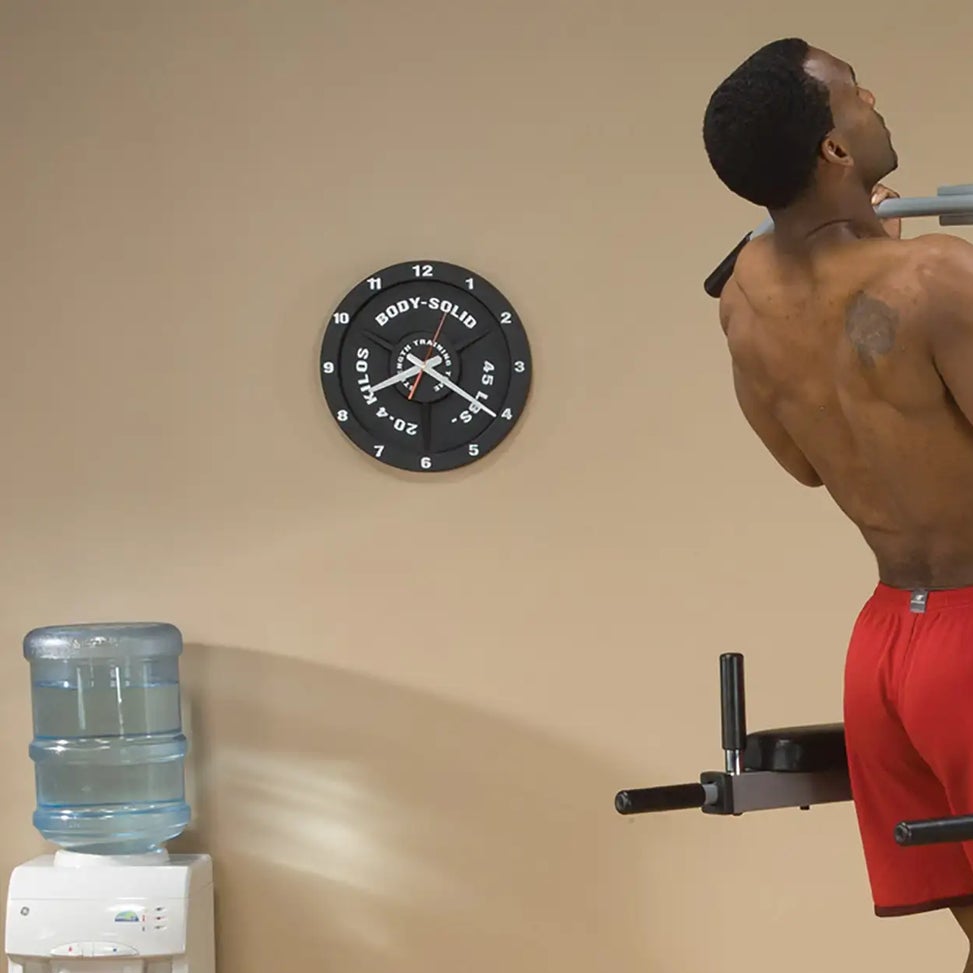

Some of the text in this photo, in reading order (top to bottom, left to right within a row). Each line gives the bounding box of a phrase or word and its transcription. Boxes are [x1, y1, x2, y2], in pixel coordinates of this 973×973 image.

[412, 264, 433, 277] 12
[367, 278, 381, 290] 11
[466, 278, 474, 289] 1
[333, 313, 349, 324] 10
[375, 297, 477, 329] BODY-SOLID
[501, 312, 511, 324] 2
[413, 339, 452, 367] TRAINING
[323, 362, 334, 373] 9
[514, 361, 525, 372] 3
[355, 348, 377, 405] KILOS
[481, 360, 495, 386] 45
[337, 409, 348, 421] 8
[501, 408, 512, 420] 4
[374, 445, 384, 457] 7
[469, 444, 479, 456] 5
[421, 457, 431, 469] 6
